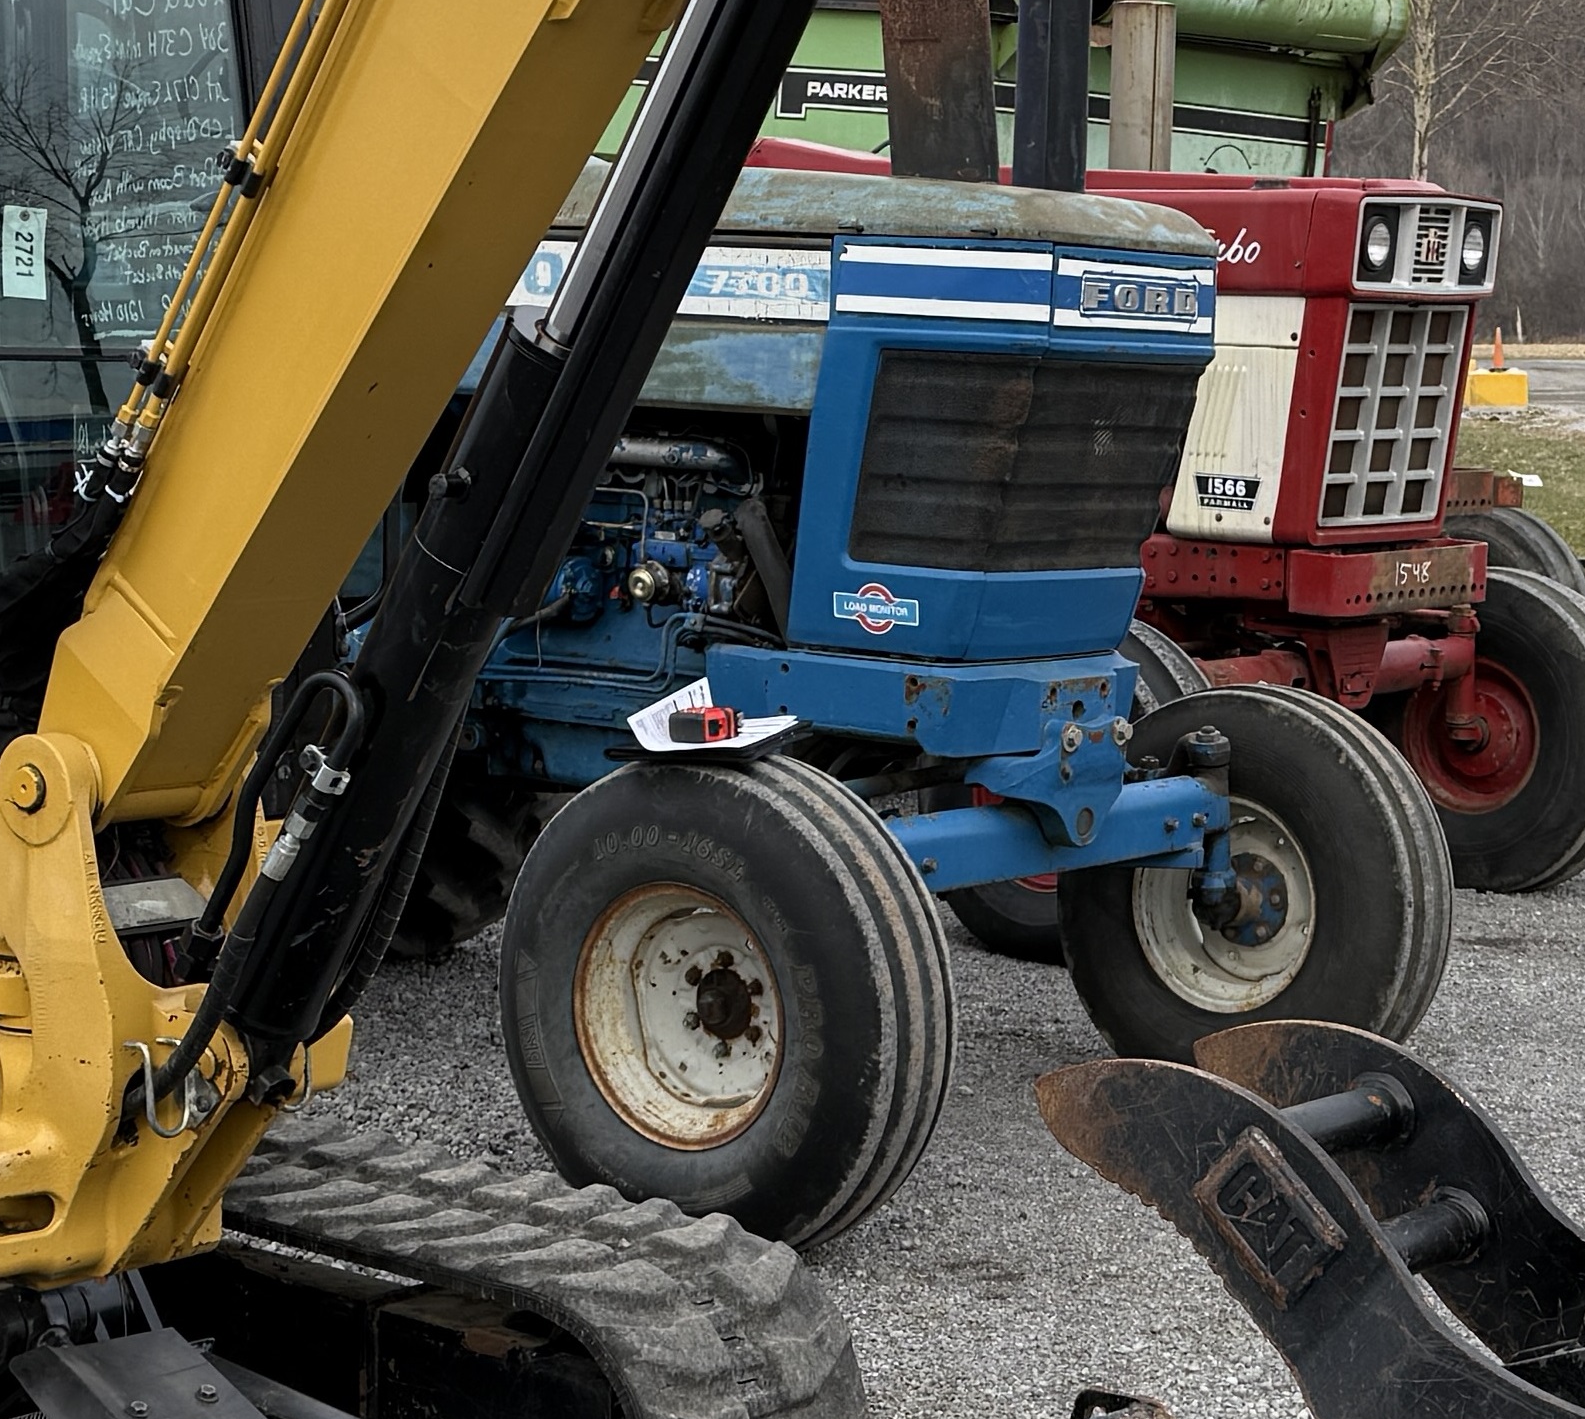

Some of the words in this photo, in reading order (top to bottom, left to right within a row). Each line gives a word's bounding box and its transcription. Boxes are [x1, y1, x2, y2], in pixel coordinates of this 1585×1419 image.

[807, 81, 888, 101] PARKER
[14, 231, 35, 278] 2721
[1083, 281, 1196, 315] FORD
[1207, 476, 1247, 497] 1566
[1395, 560, 1432, 586] 1548
[843, 601, 867, 613] LOAD
[868, 604, 908, 617] MONITOR
[1218, 1161, 1317, 1277] CAT
